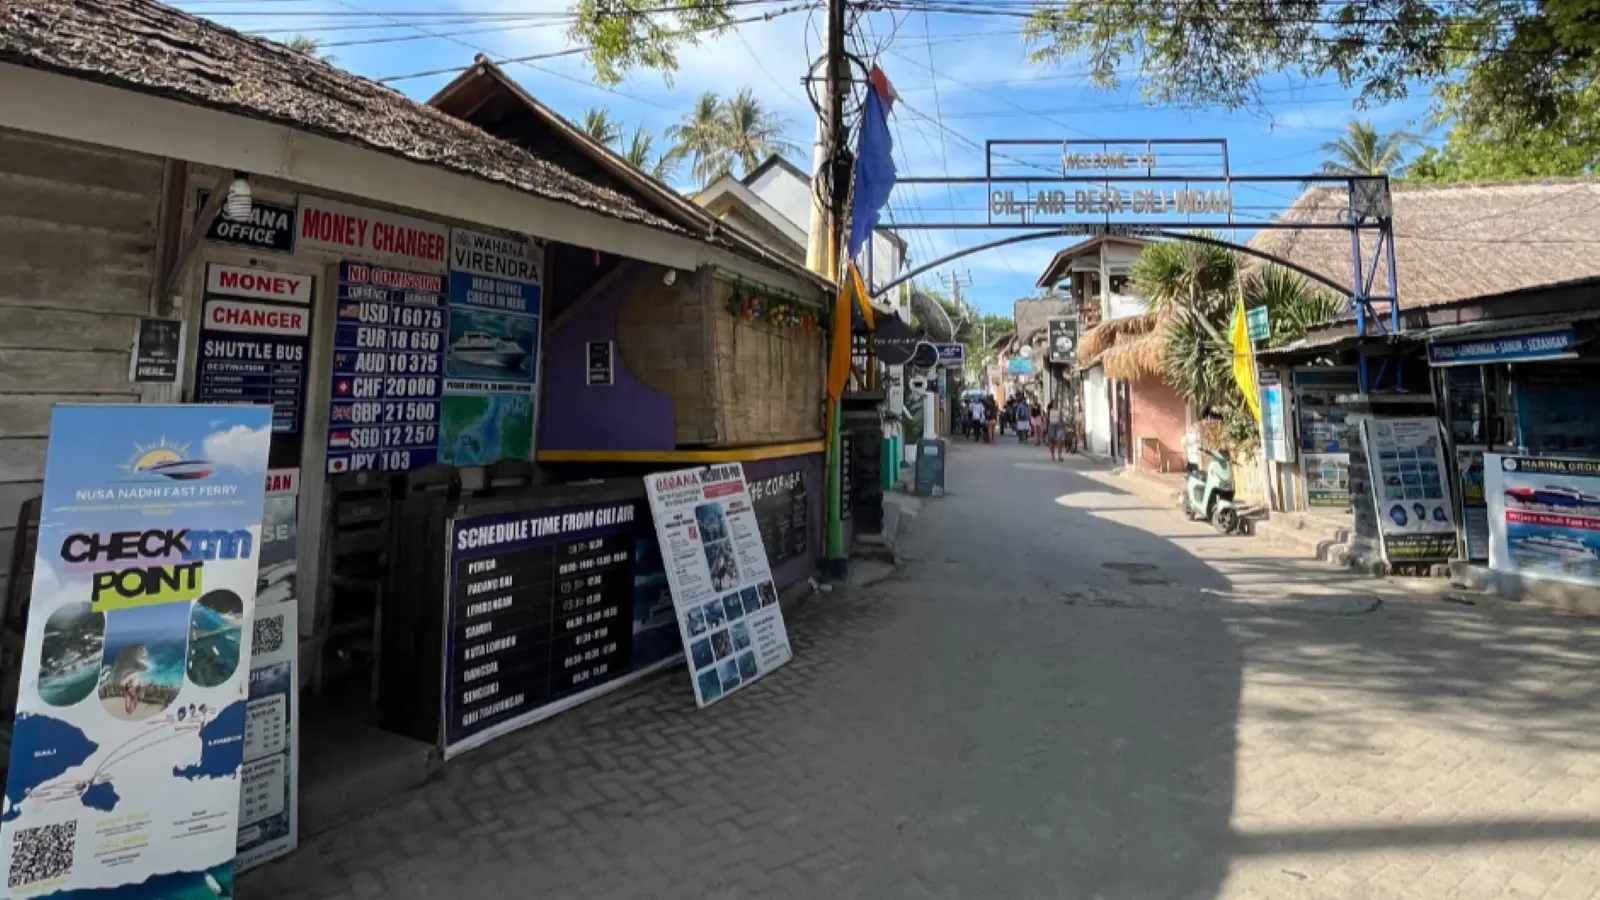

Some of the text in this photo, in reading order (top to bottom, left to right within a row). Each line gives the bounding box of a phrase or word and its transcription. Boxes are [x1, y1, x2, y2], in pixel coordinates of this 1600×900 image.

[1063, 153, 1129, 169] WELCOME
[1035, 189, 1066, 215] AIR
[1075, 189, 1124, 215] DESA
[1131, 189, 1167, 215] GILI
[1173, 188, 1232, 214] INDAH
[216, 222, 276, 245] OFFICE
[302, 208, 445, 262] MONEY CHANGER
[474, 235, 525, 257] WAHANA
[348, 265, 370, 283] NO
[455, 247, 539, 282] VIRENDRA
[220, 271, 300, 295] MONEY
[212, 306, 302, 330] CHANGER
[358, 302, 389, 324] USD
[356, 327, 387, 348] EUR
[204, 338, 304, 361] SHUTTLE BUS
[355, 352, 385, 373] AUD
[352, 377, 384, 399] CHF
[351, 402, 382, 424] GBP
[350, 428, 380, 449] SGD
[350, 451, 411, 471] JPY 103
[1520, 458, 1565, 470] MARINA
[76, 485, 237, 500] NUSA NADHI FAST FERRY
[457, 519, 528, 550] SCHEDULE
[530, 514, 561, 538] TIME
[562, 509, 594, 533] FROM
[61, 528, 190, 563] CHECK
[91, 560, 204, 602] POINT
